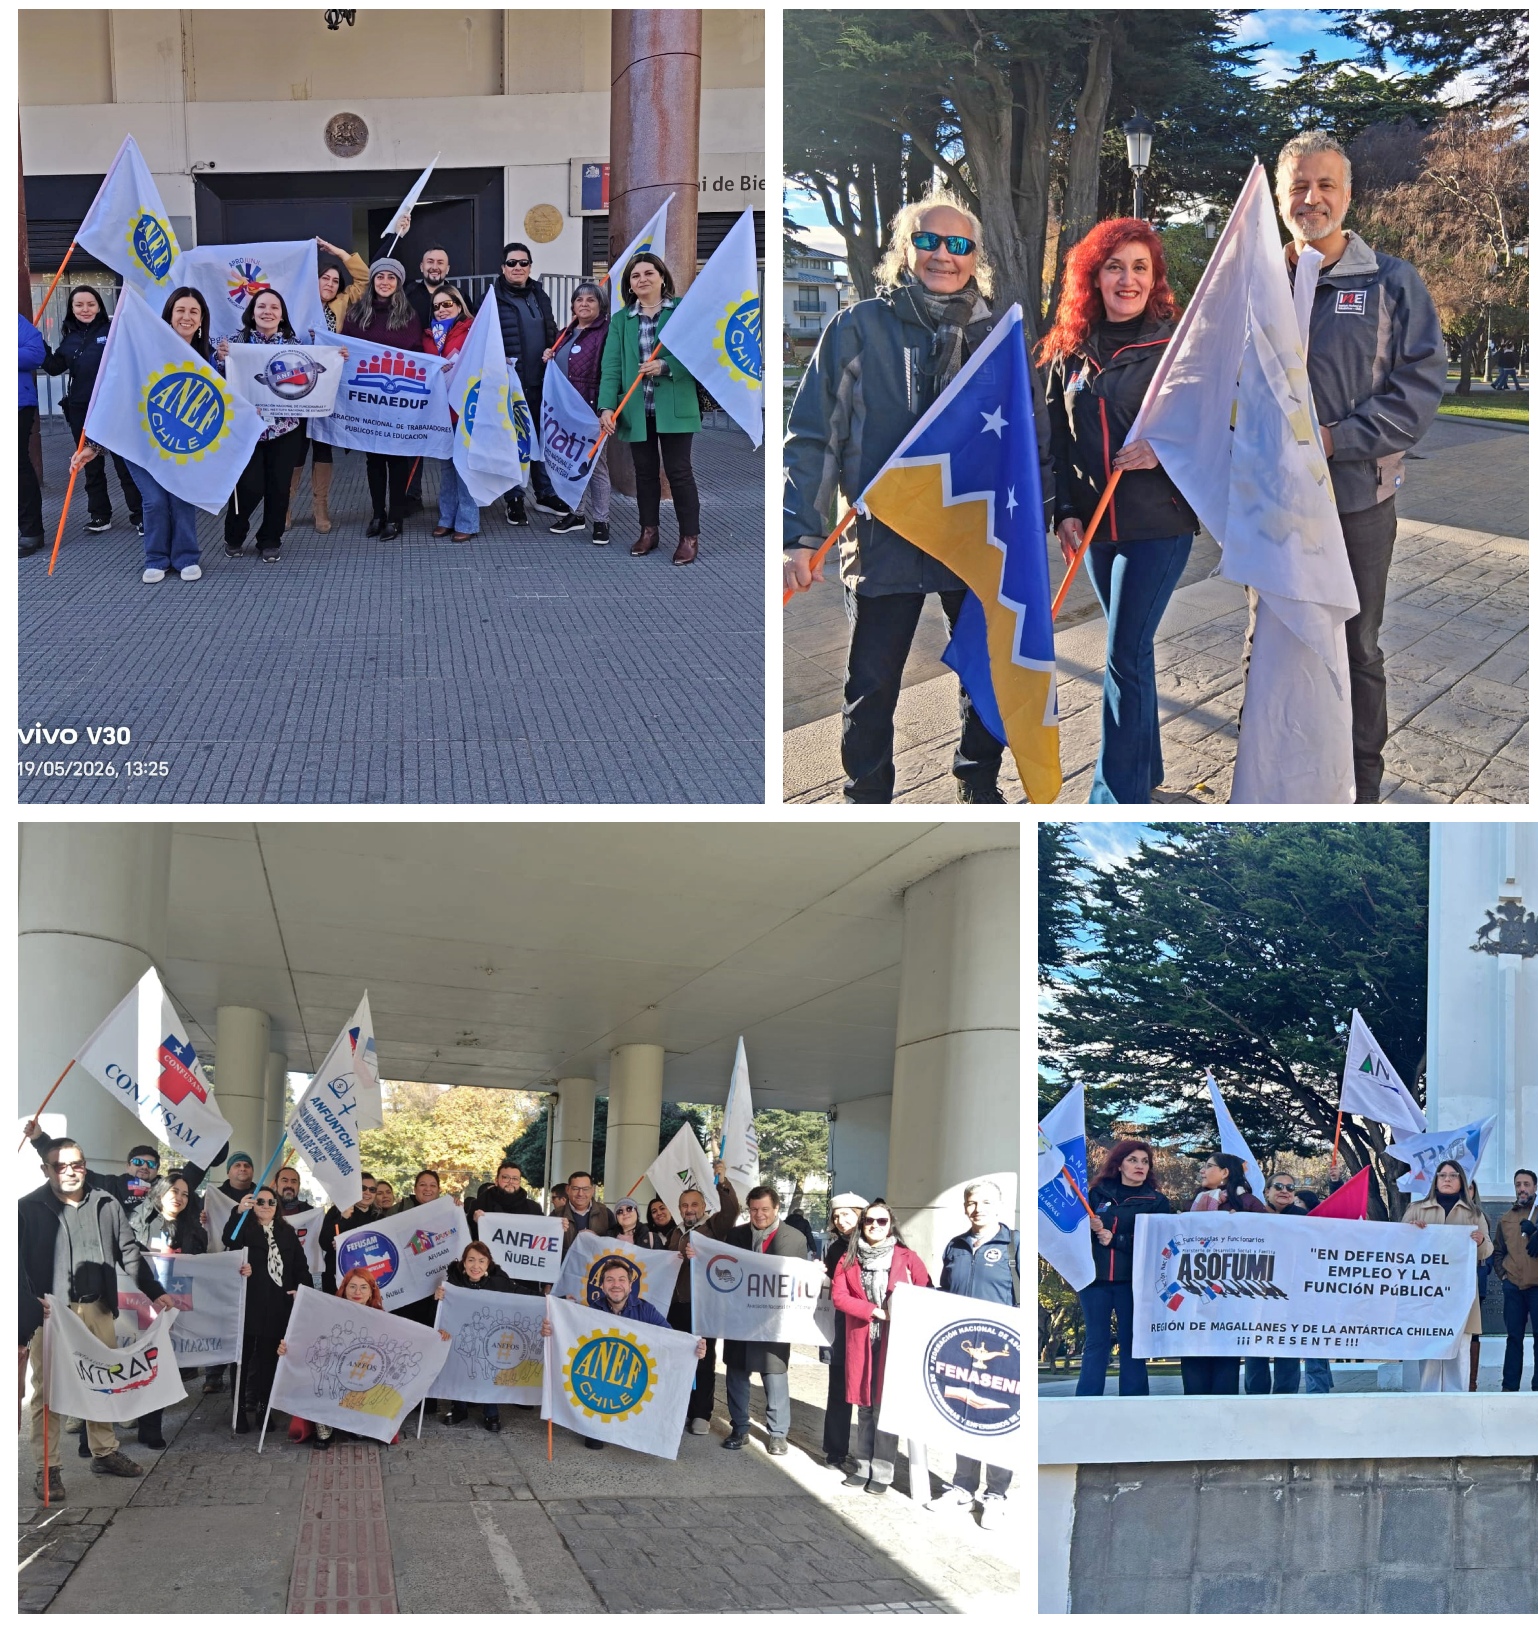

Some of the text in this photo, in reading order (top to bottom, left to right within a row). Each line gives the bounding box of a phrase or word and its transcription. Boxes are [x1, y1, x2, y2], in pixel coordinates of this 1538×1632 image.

[712, 175, 734, 191] de
[149, 374, 218, 437] ANEF
[348, 390, 429, 410] FENAEDUP
[151, 412, 200, 453] CHILE
[362, 418, 452, 433] NACIONAL DE TRABAJADORES
[392, 432, 428, 440] EDUCACION
[164, 1055, 203, 1093] CONFUSAM
[310, 1096, 356, 1148] ANFUNTCH
[346, 1236, 378, 1252] FEFUSAM
[492, 1228, 558, 1253] ANFINE
[428, 1248, 450, 1261] AFUSAM
[504, 1250, 546, 1268] ÑUBLE
[1344, 1249, 1416, 1265] DEFENSA
[1420, 1253, 1450, 1266] DEL
[1177, 1252, 1275, 1282] ASOFUMI
[1328, 1266, 1431, 1281] EMPLEO Y LA
[958, 1325, 1008, 1341] NACIONAL DE
[1151, 1319, 1455, 1337] REGIÓN DE MAGALLANES Y DE LA ANTÁRTICA CHILENA
[575, 1341, 642, 1390] ANEF
[579, 1384, 633, 1410] CHILE
